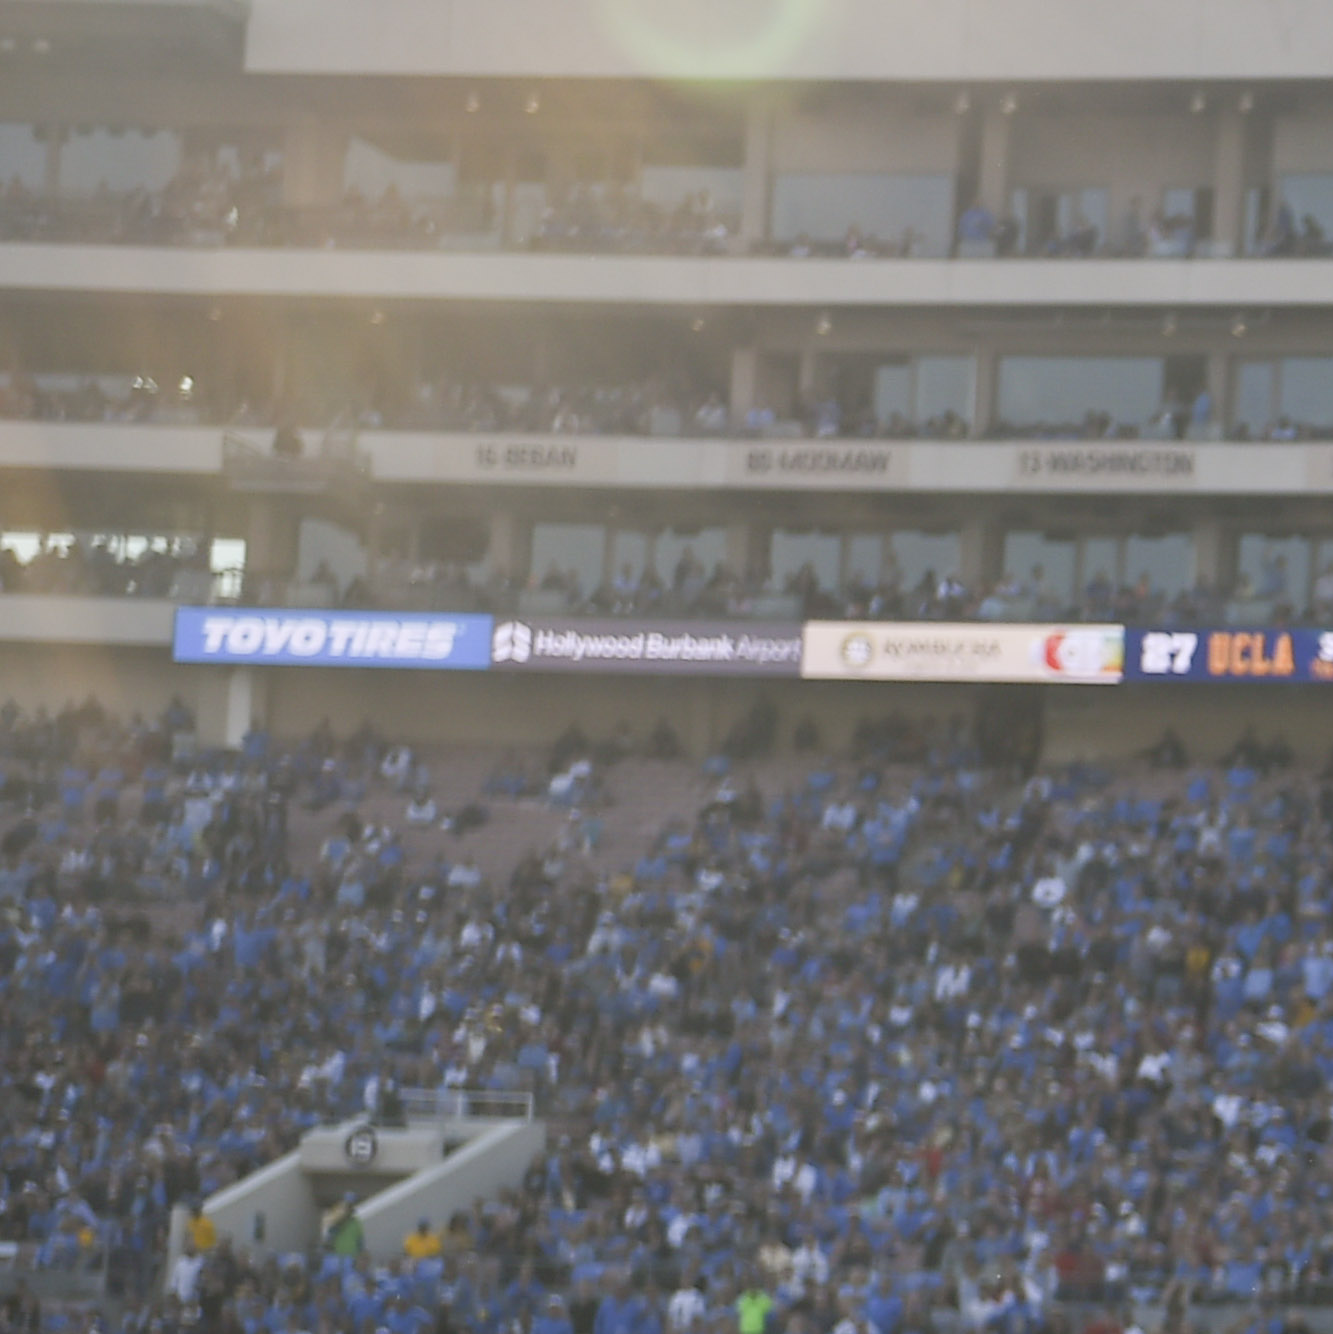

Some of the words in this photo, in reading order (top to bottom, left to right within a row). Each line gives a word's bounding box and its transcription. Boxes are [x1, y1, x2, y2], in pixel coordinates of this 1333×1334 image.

[203, 617, 326, 655] TOYO
[329, 620, 457, 660] TIRES
[534, 630, 645, 661] Hollywood
[646, 633, 733, 660] Burbank
[1208, 632, 1295, 675] UCLA
